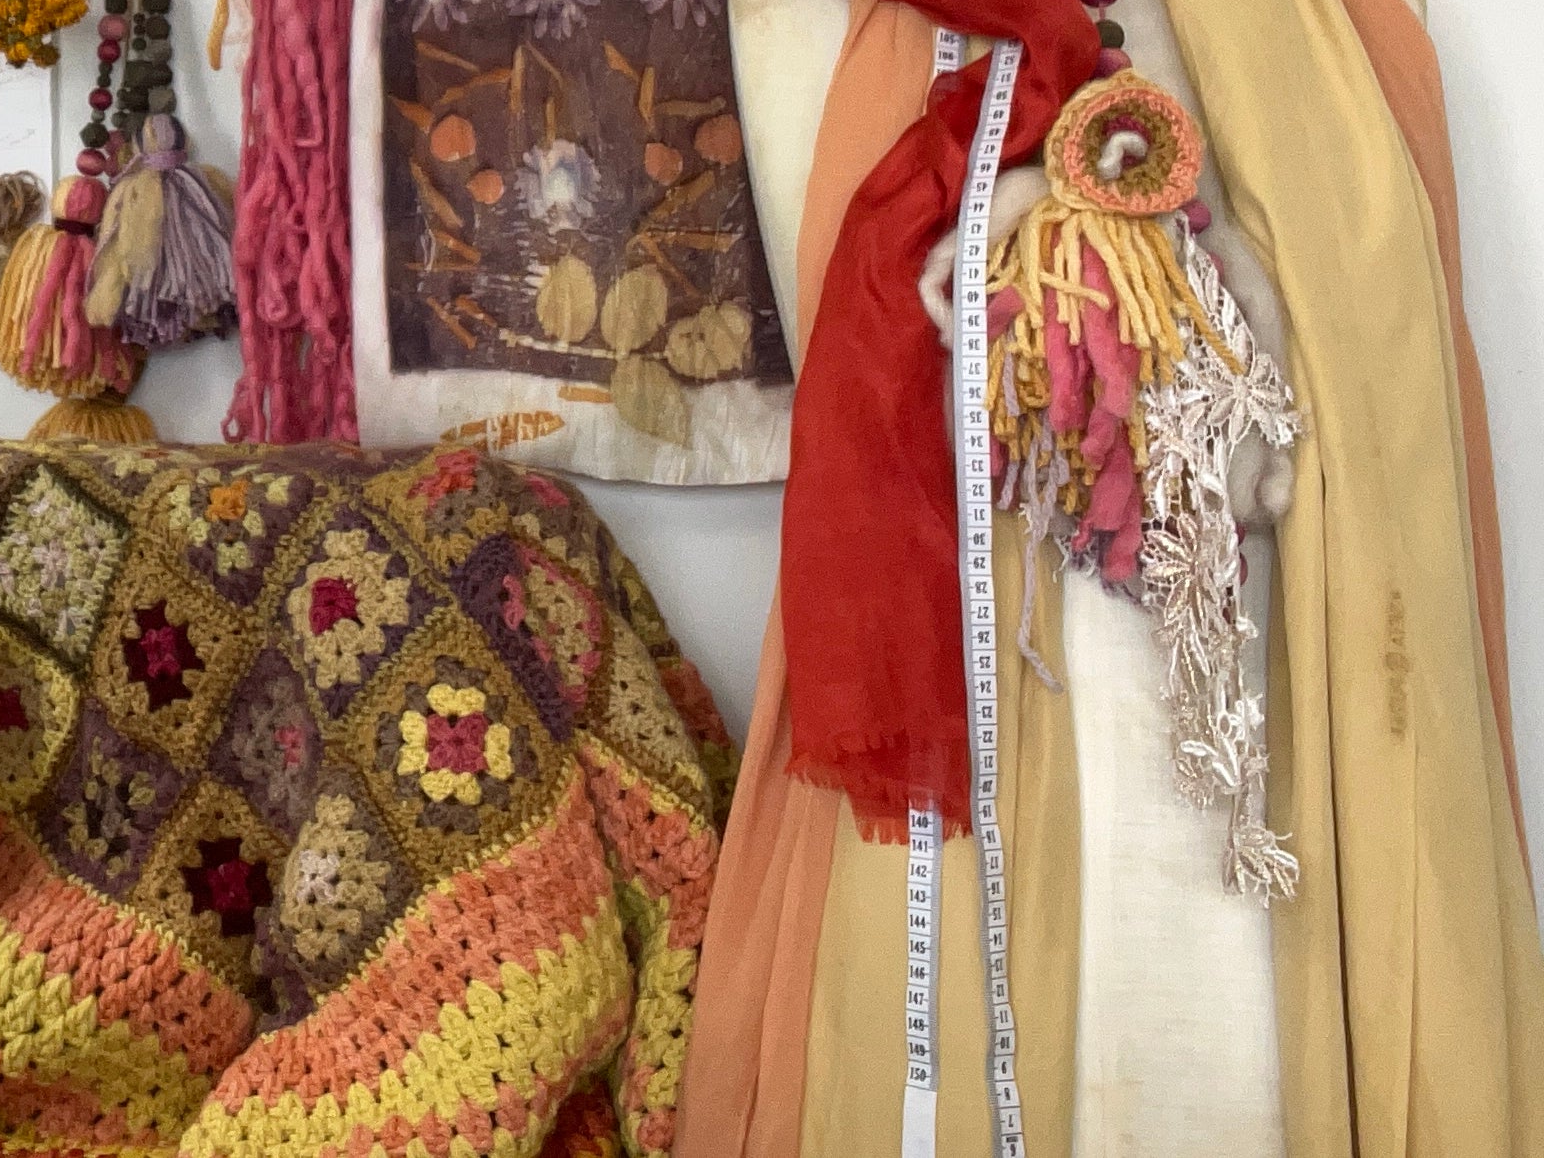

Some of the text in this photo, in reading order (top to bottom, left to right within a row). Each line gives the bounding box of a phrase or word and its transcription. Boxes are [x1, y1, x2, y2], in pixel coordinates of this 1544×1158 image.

[983, 144, 996, 155] 47
[980, 163, 992, 173] 46
[976, 182, 988, 192] 45
[973, 202, 985, 213] 44
[970, 223, 983, 235] 43
[968, 245, 981, 256] 42
[968, 268, 980, 279] 41
[967, 291, 979, 303] 40
[968, 314, 980, 326] 39
[968, 338, 981, 351] 38
[968, 362, 981, 375] 37
[968, 387, 981, 399] 36
[969, 411, 982, 423] 35
[970, 435, 984, 447] 34
[971, 459, 984, 472] 33
[972, 484, 985, 497] 32
[973, 508, 985, 521] 31
[973, 532, 985, 545] 30
[973, 556, 986, 569] 29
[975, 581, 987, 594] 28
[977, 606, 989, 619] 27
[977, 630, 990, 643] 26
[979, 655, 991, 669] 25
[980, 680, 992, 693] 24
[981, 705, 993, 719] 23
[982, 730, 993, 743] 22
[983, 755, 994, 768] 21
[911, 814, 929, 829] 140
[911, 839, 928, 853] 141
[990, 856, 999, 869] 17
[910, 863, 927, 878] 142
[909, 888, 926, 903] 143
[909, 914, 926, 929] 144
[909, 939, 926, 954] 145
[909, 965, 925, 980] 146
[908, 990, 924, 1005] 147
[999, 1009, 1008, 1023] 11
[910, 1067, 927, 1082] 150
